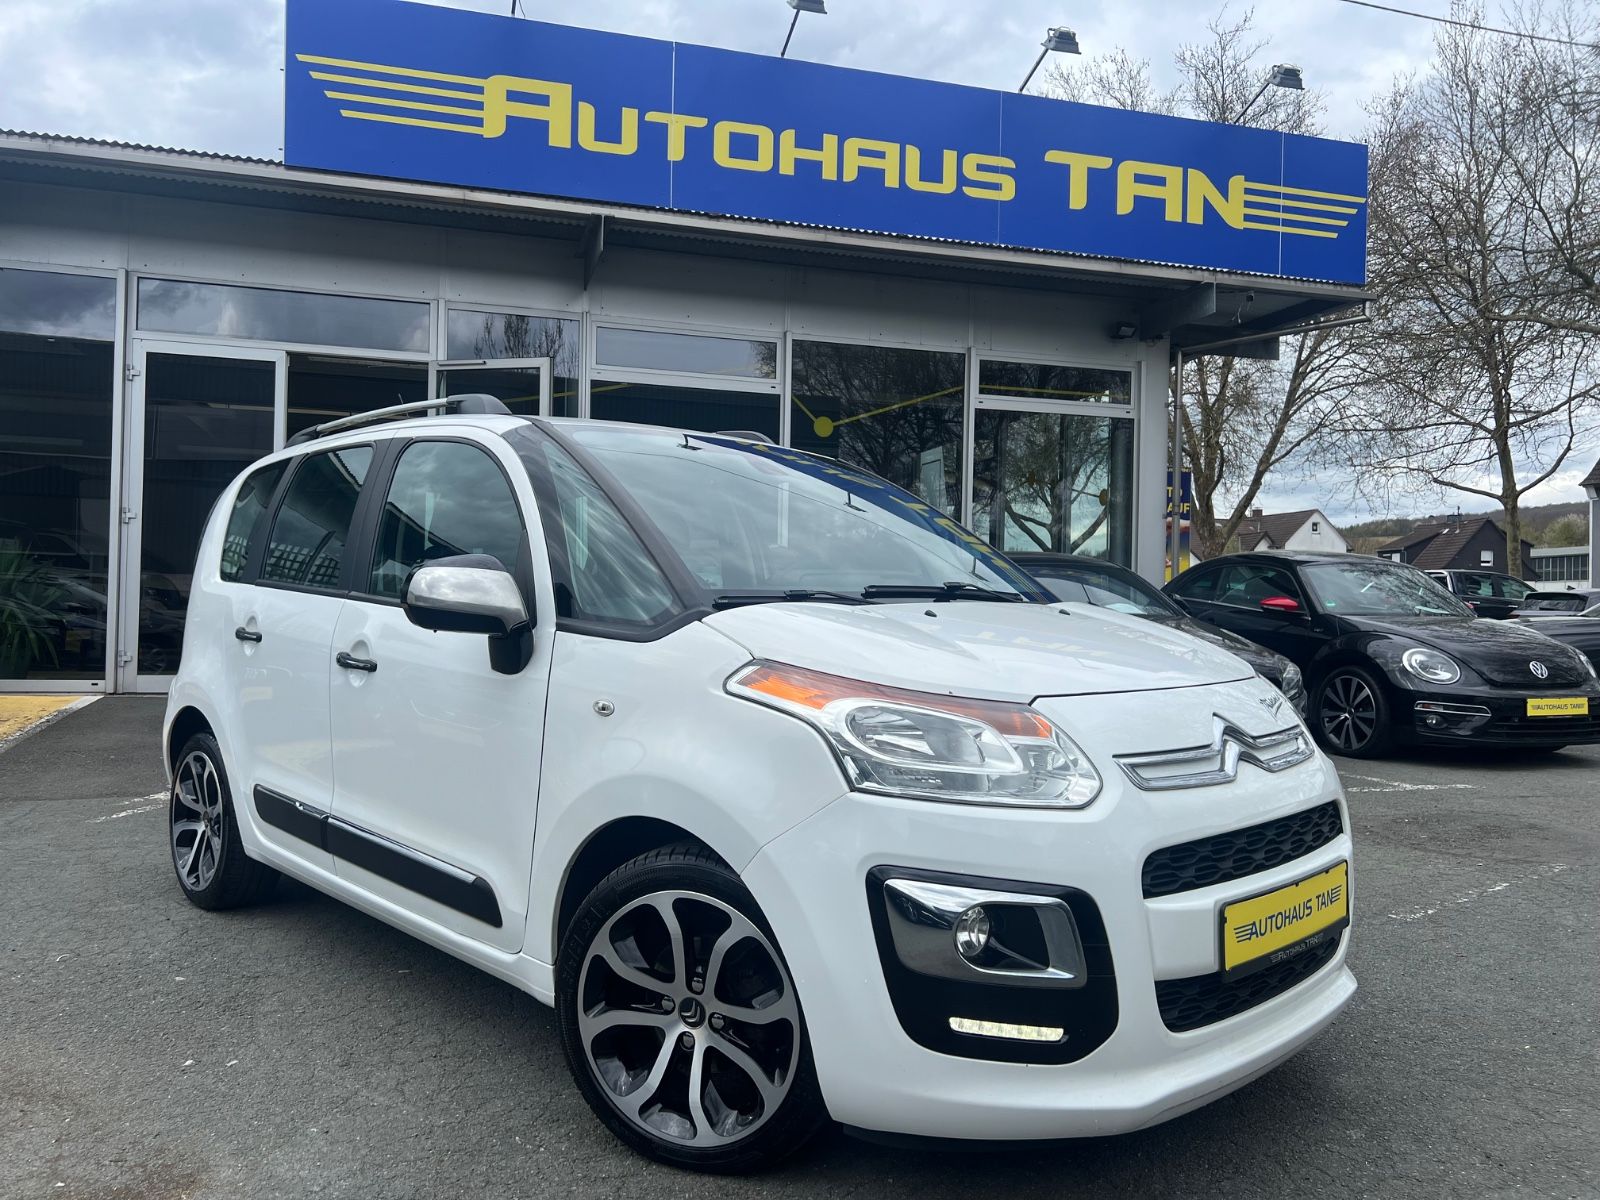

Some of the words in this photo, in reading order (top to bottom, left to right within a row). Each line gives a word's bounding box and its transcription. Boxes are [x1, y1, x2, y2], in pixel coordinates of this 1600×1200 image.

[483, 74, 1016, 202] AUTOHAUS
[1044, 149, 1244, 230] TAN
[1537, 703, 1569, 711] AUTOHAUS
[1249, 898, 1313, 941] AUTOHAUS
[1315, 888, 1334, 912] TAN
